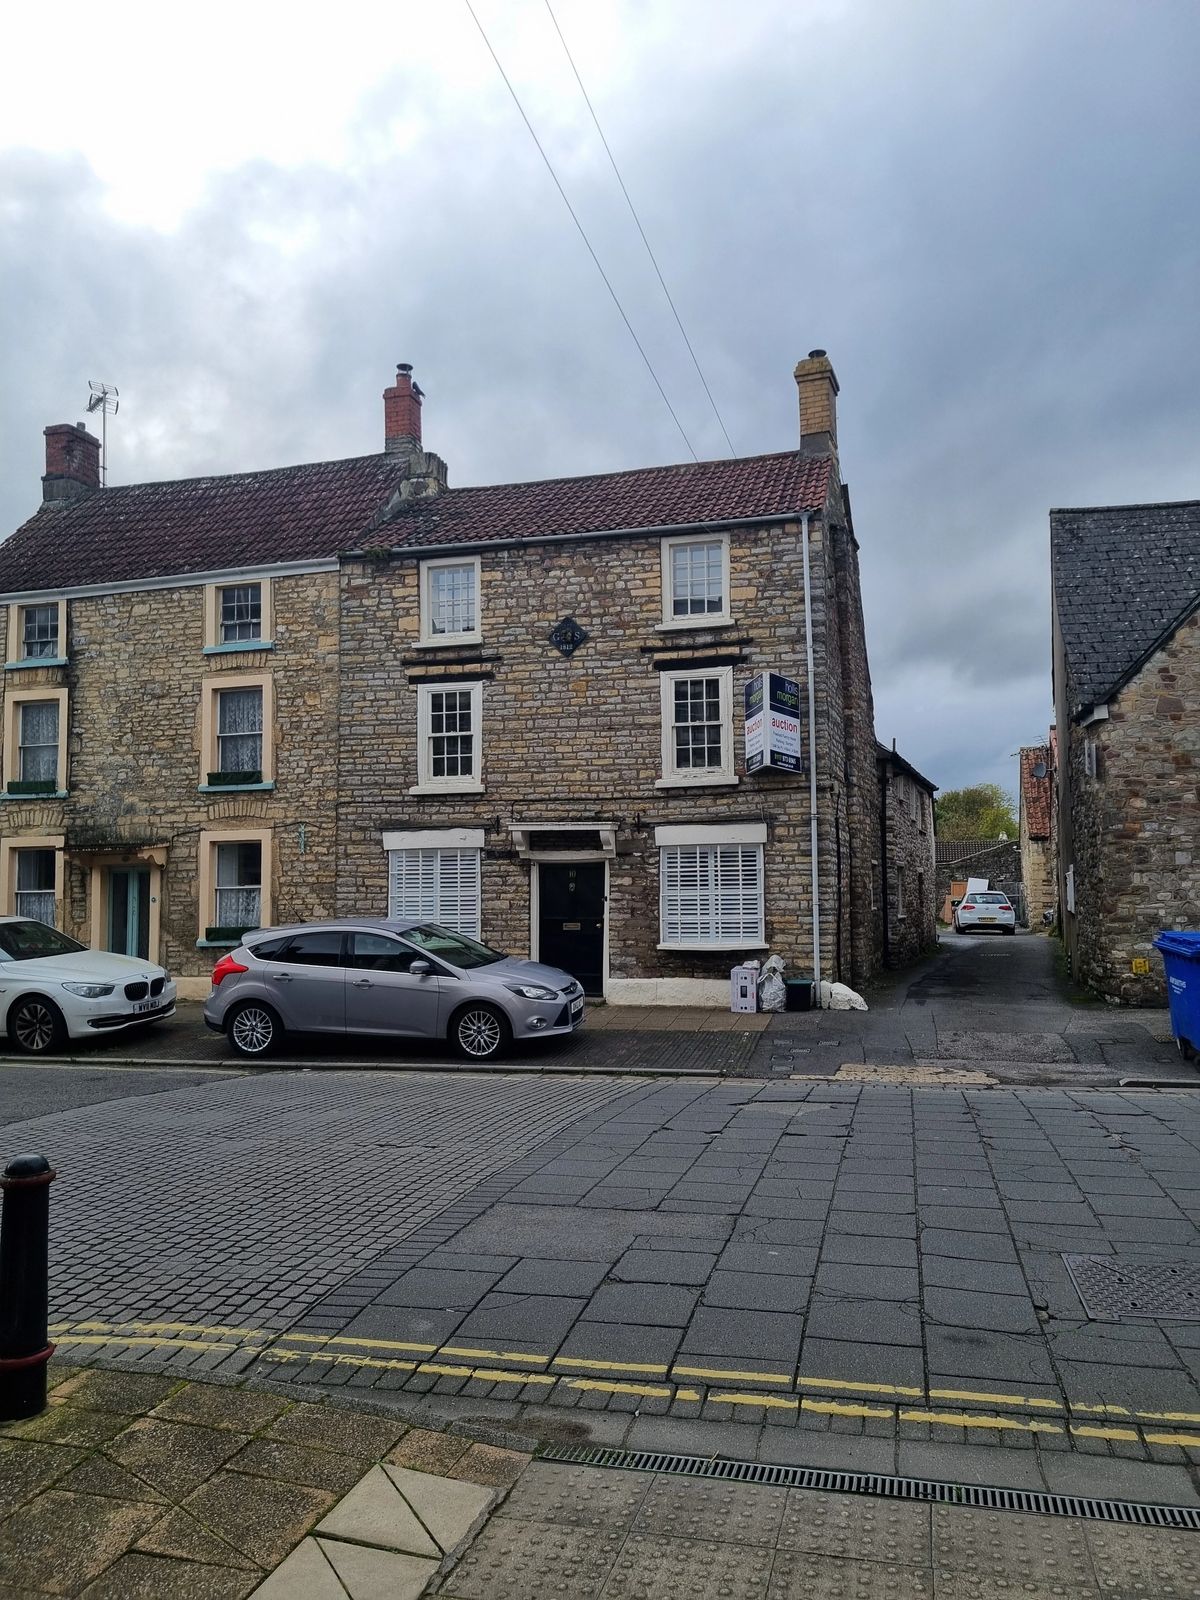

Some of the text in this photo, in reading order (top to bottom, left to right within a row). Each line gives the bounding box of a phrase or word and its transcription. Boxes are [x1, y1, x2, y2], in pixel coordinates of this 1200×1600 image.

[777, 691, 798, 706] morgan
[746, 719, 762, 734] auction
[772, 718, 797, 733] auction
